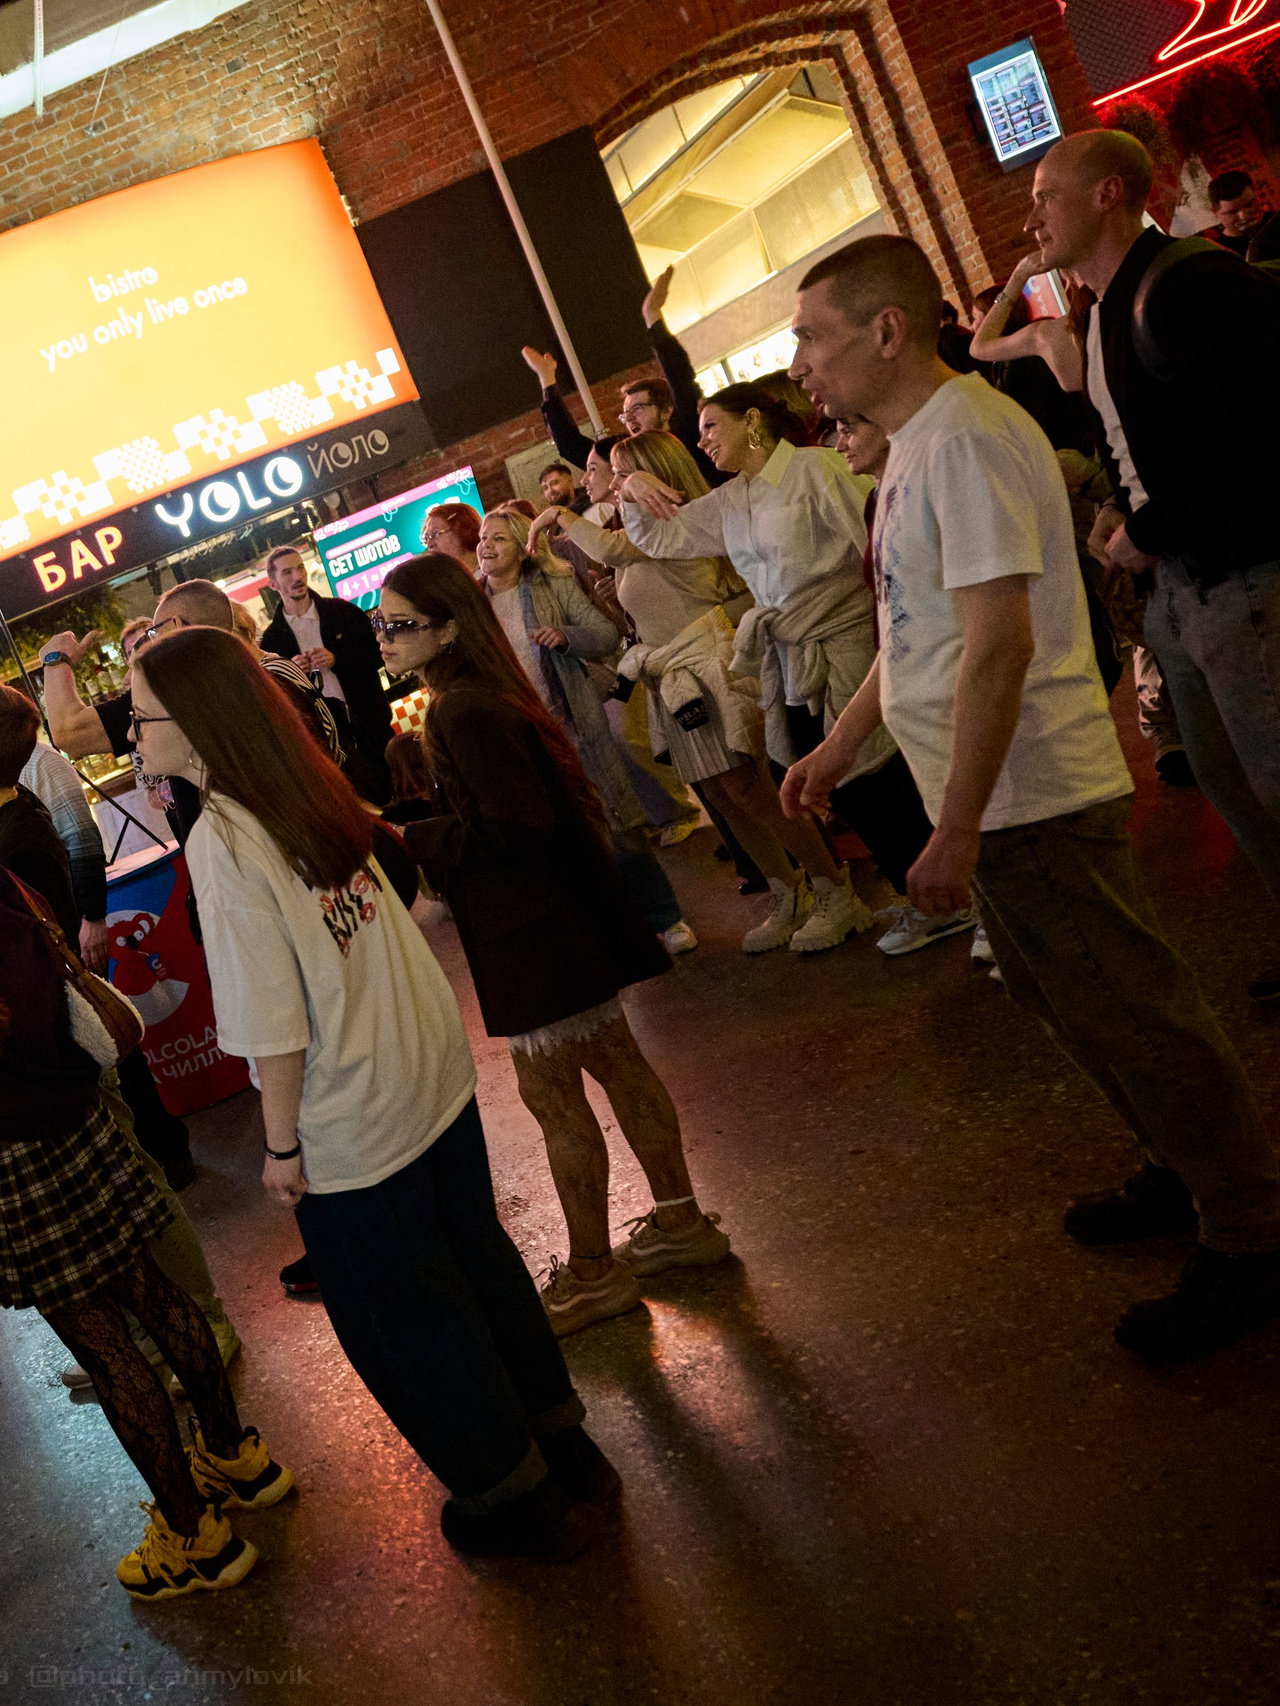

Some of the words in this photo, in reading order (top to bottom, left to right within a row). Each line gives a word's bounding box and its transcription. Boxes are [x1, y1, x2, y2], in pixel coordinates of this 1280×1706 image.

[87, 266, 158, 303] bistro
[39, 333, 88, 373] you
[93, 306, 143, 339] only
[144, 296, 190, 324] live
[193, 277, 248, 308] once
[307, 429, 390, 478] ЙОЛО
[154, 455, 304, 538] YOLO
[32, 525, 124, 594] БАР
[328, 552, 354, 578] СЕТ
[353, 534, 401, 568] ШОТОВ
[342, 581, 352, 597] 4
[361, 573, 371, 589] 1
